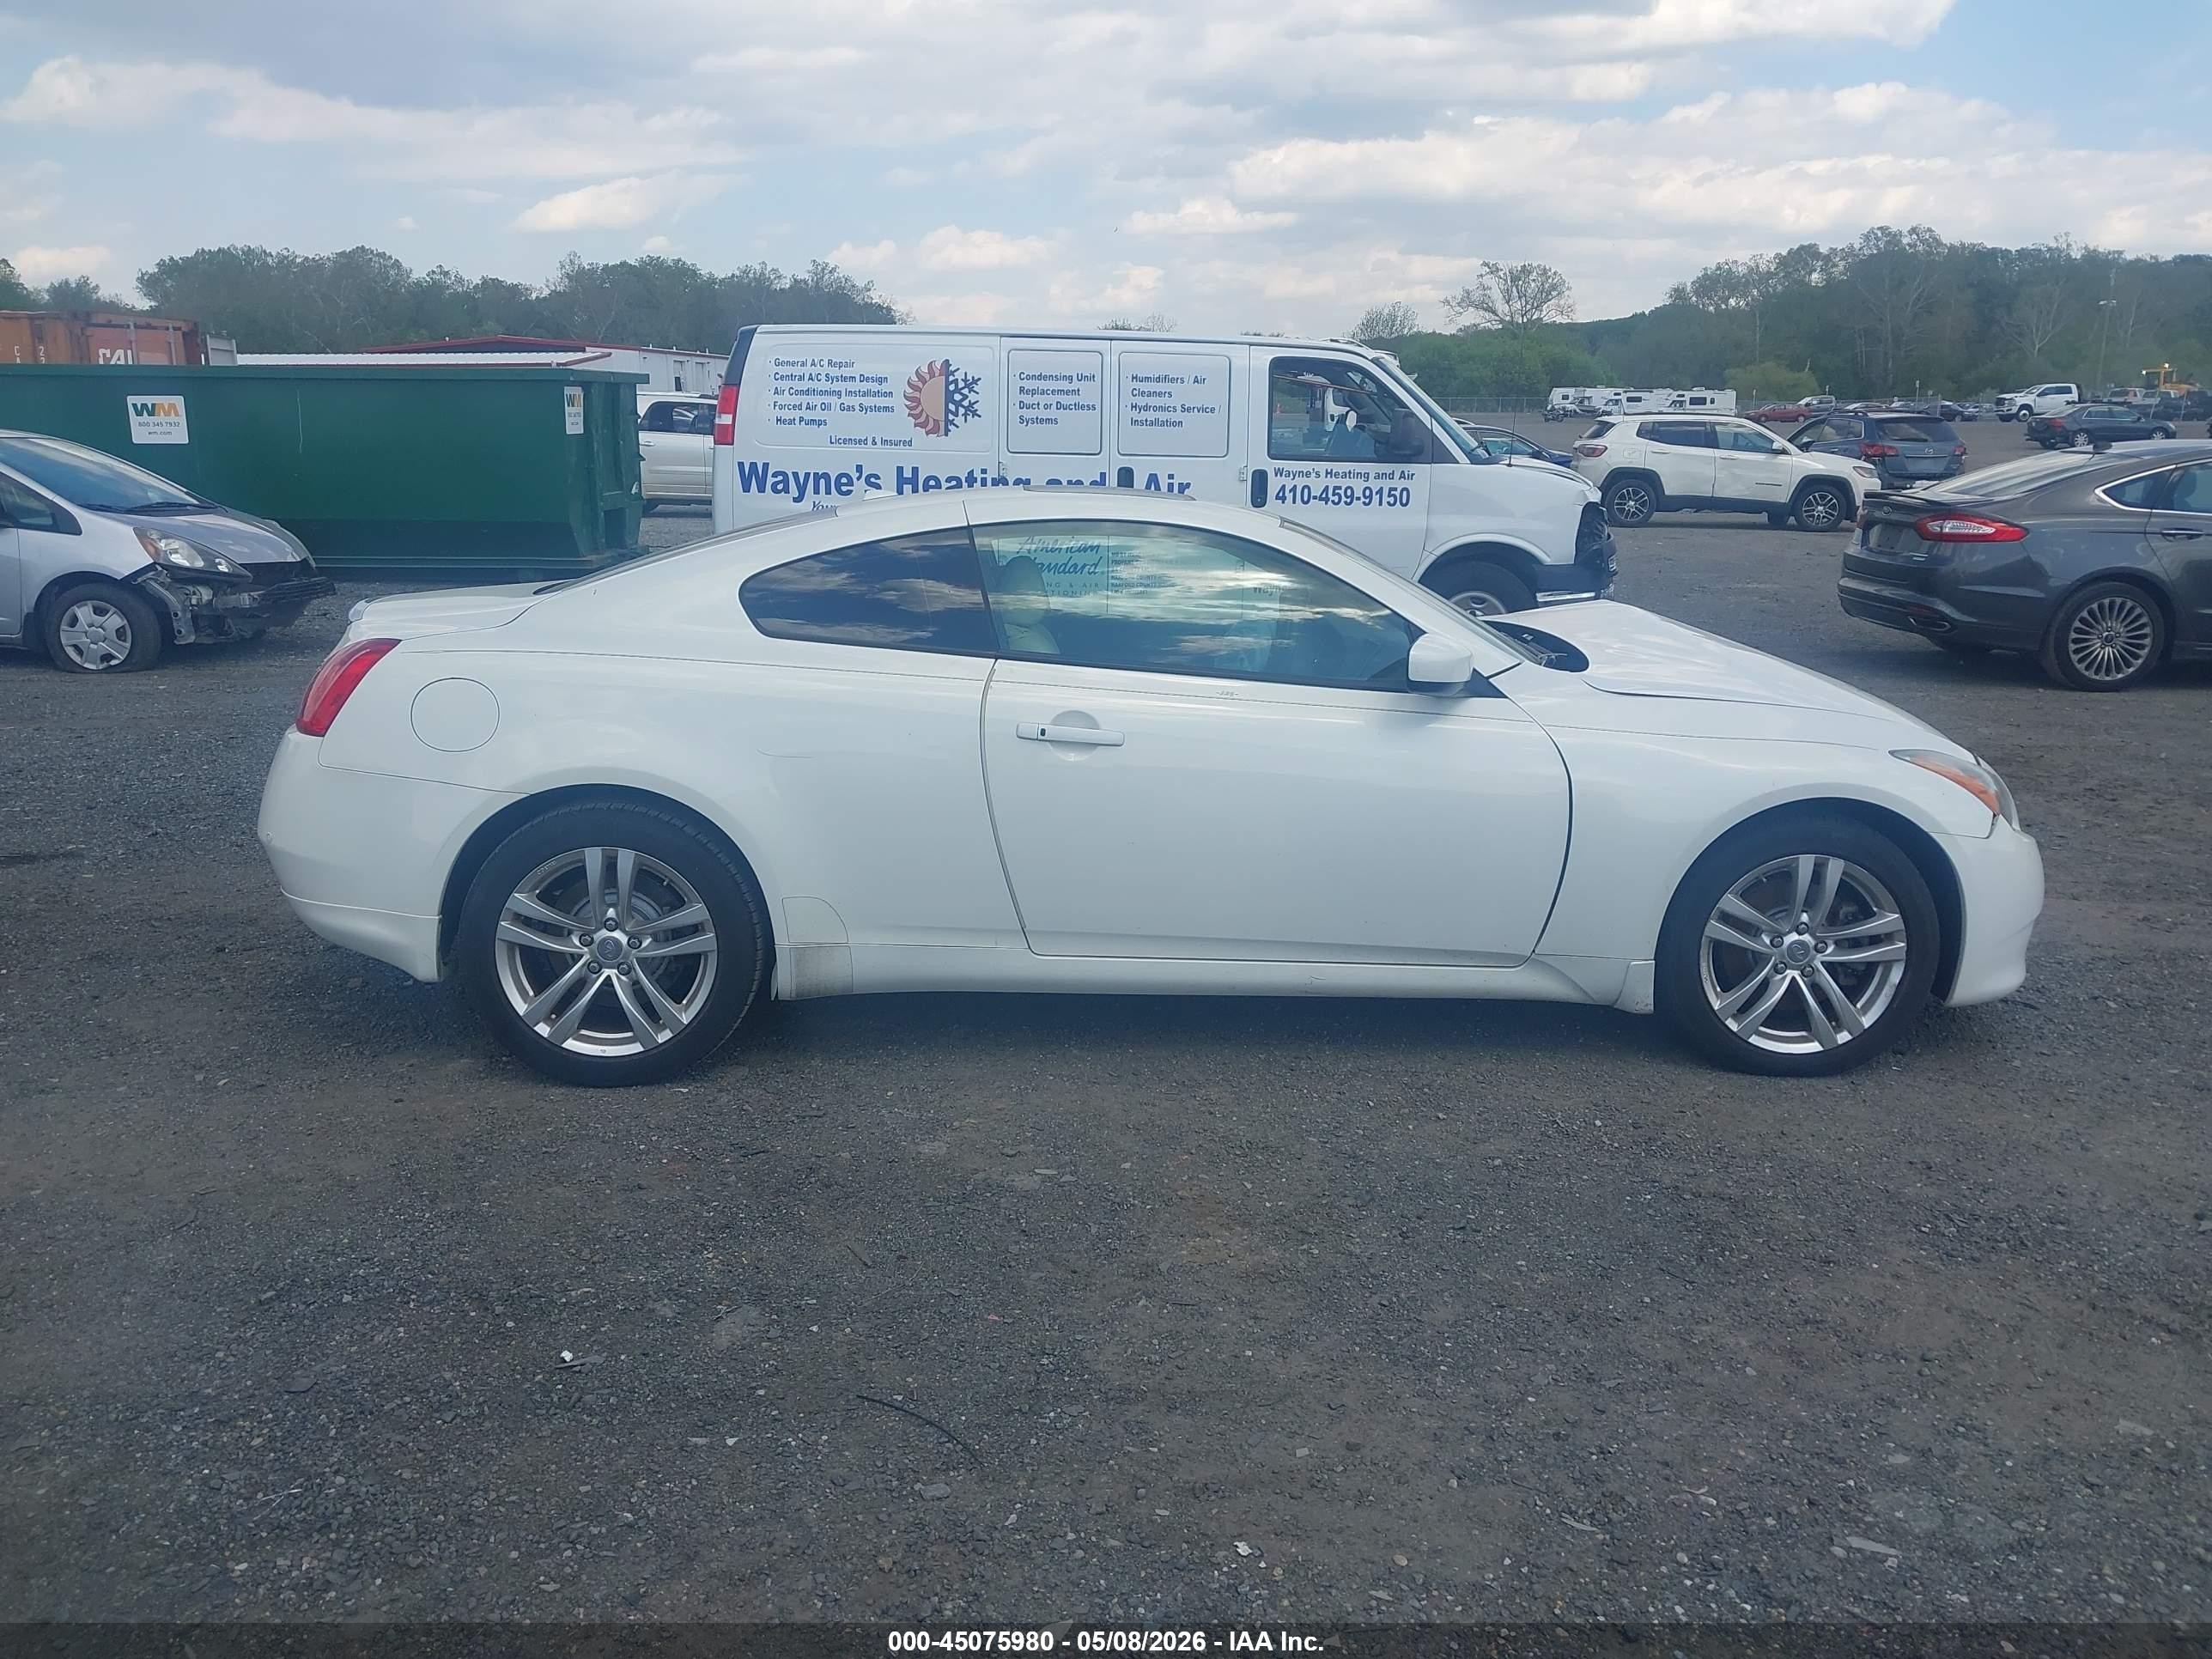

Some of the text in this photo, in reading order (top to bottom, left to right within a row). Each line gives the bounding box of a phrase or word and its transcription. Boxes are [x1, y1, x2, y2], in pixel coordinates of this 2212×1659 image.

[774, 358, 855, 370] General A/C Repair
[774, 372, 889, 386] Central A/C System Design
[1018, 371, 1096, 384] Condensing Unit
[1131, 374, 1185, 385] Humidifiers
[1193, 375, 1207, 385] Air
[773, 386, 894, 399] Air Conditioning Installation
[1018, 386, 1081, 398] Replacement
[1131, 388, 1173, 398] Cleaners
[131, 403, 179, 416] WM
[773, 401, 803, 410] Forced
[805, 402, 818, 410] Air
[820, 402, 831, 411] Oil
[839, 403, 856, 412] Gas
[859, 403, 895, 415] Systems
[1018, 400, 1040, 410] Duct
[1055, 401, 1097, 411] Ductless
[1130, 402, 1177, 414] Hydronics
[1180, 404, 1216, 414] Service
[775, 416, 828, 428] Heat Pumps
[1018, 415, 1059, 427] Systems
[1130, 416, 1183, 428] Installation
[830, 434, 913, 447] Licensed & Insured
[1273, 466, 1416, 483] Wayne's Heating and Air
[737, 461, 883, 503] Wayne's
[1274, 483, 1411, 507] 410-459-9150
